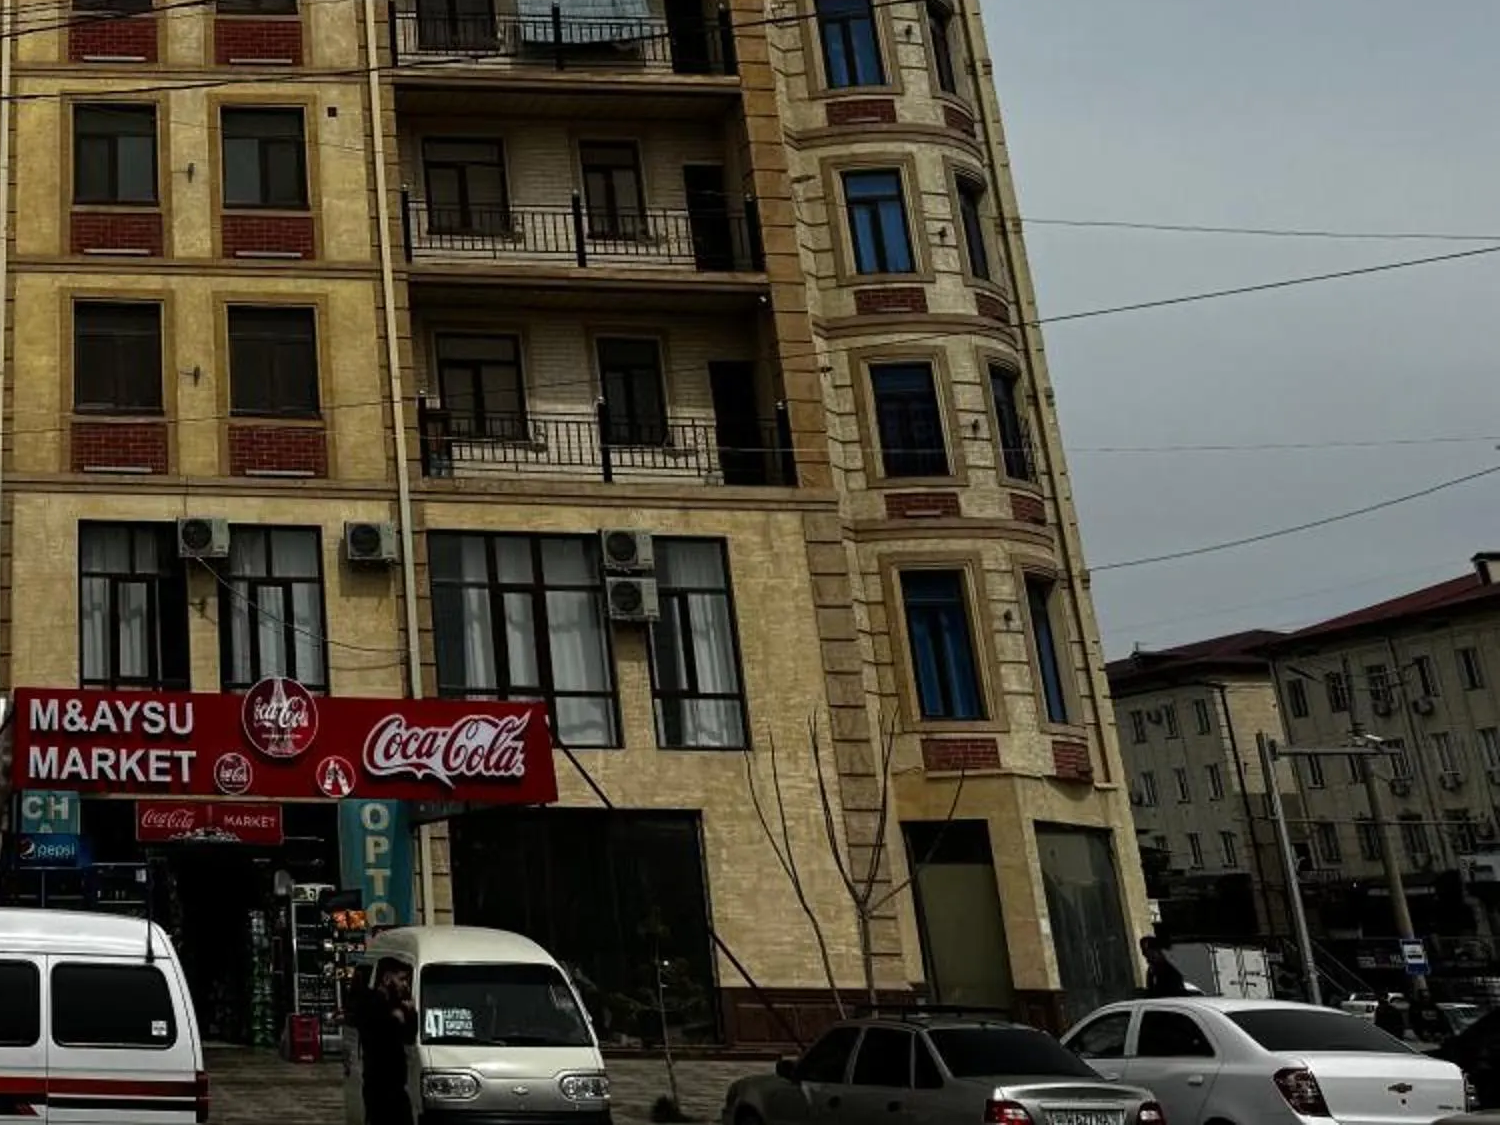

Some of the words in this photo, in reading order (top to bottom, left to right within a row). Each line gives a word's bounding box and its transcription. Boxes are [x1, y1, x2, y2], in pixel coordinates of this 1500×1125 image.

[29, 698, 194, 735] M&AYSU
[28, 745, 197, 784] MARKET
[363, 708, 533, 789] Coca-Cola
[223, 814, 275, 828] MARKET
[37, 842, 76, 860] pepsi
